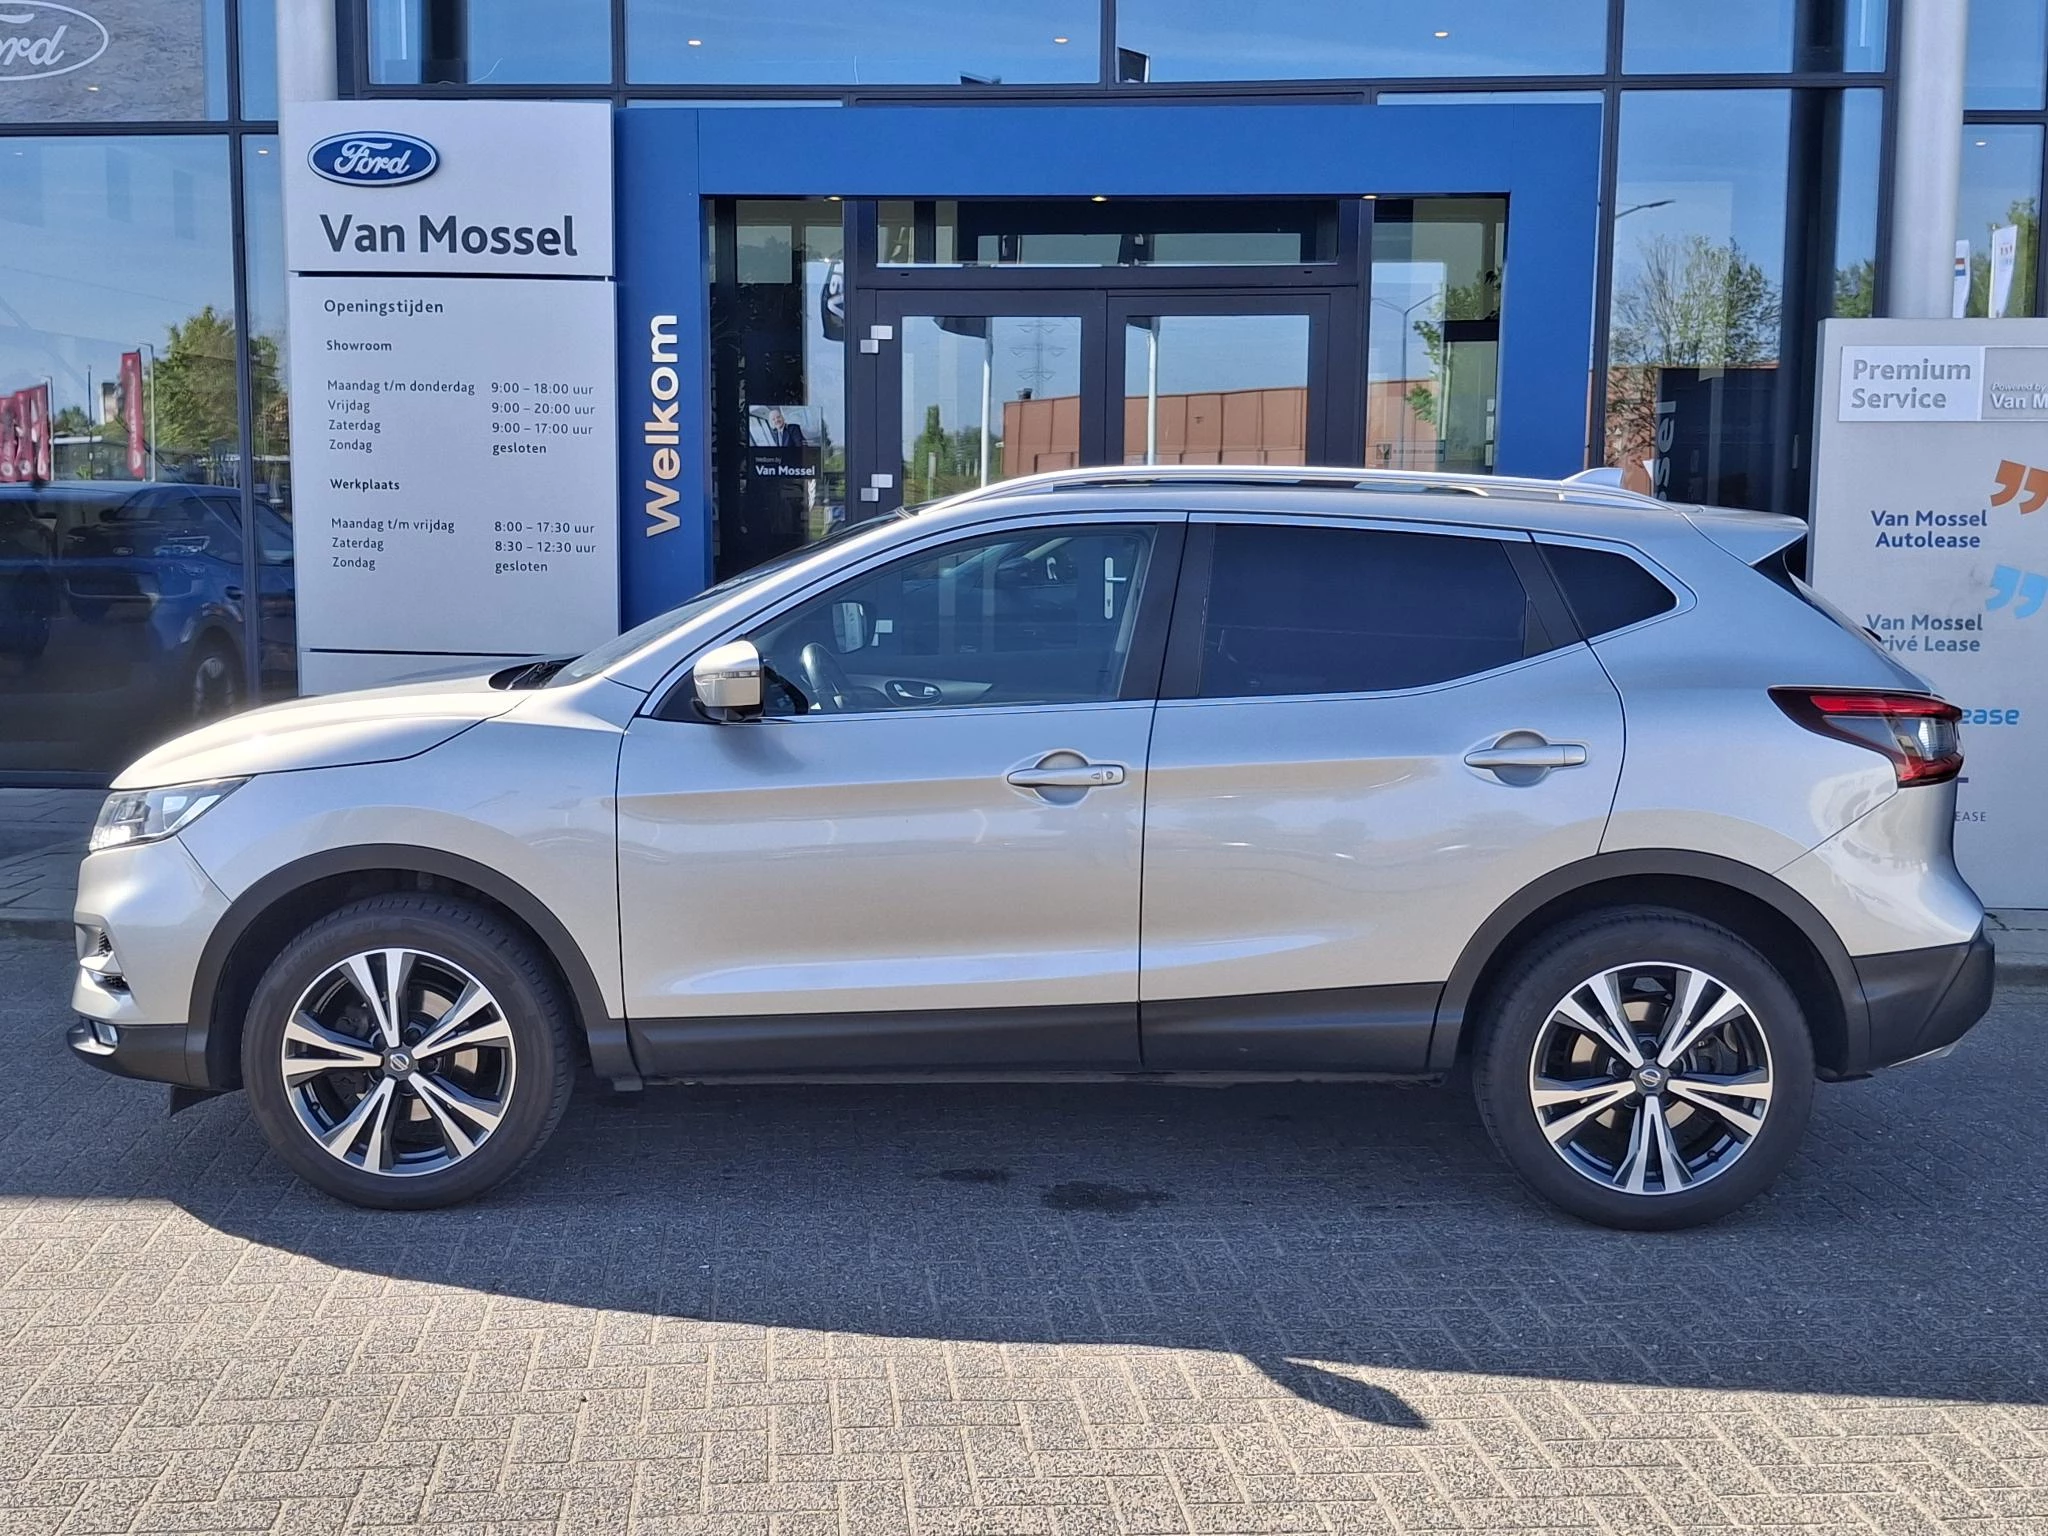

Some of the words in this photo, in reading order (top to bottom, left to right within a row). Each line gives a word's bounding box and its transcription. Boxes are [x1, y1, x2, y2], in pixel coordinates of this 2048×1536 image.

[333, 140, 412, 174] Ford
[320, 214, 406, 253] Van
[419, 215, 578, 257] Mossel
[324, 299, 444, 317] Openingstijden
[326, 339, 392, 351] Showroom
[1853, 358, 1971, 380] Premium
[327, 379, 381, 394] Maandag
[384, 380, 406, 392] t/m
[410, 380, 475, 396] donderdag
[491, 382, 520, 394] 9:00
[534, 382, 569, 395] 18:00
[573, 386, 594, 395] uur
[1851, 386, 1947, 409] Service
[1991, 393, 2026, 409] Van
[327, 399, 370, 414] Vrijdag
[491, 402, 520, 414] 9:00
[534, 403, 571, 415] 20:00
[574, 406, 596, 415] uur
[328, 419, 381, 434] Zaterdag
[492, 422, 521, 434] 9:00
[534, 423, 569, 435] 17:00
[572, 426, 594, 435] uur
[645, 314, 681, 537] Welkom
[329, 439, 372, 454] Zondag
[492, 442, 547, 456] gesloten
[755, 465, 776, 476] Van
[778, 465, 816, 476] Mossel
[330, 478, 400, 493] Werkplaats
[331, 518, 384, 532] Maandag
[387, 518, 410, 530] t/m
[413, 519, 455, 534] vrijdag
[494, 521, 523, 533] 8:00
[537, 522, 571, 534] 17:30
[574, 525, 595, 534] uur
[1871, 510, 1909, 526] Van
[1915, 509, 1988, 526] Mossel
[332, 537, 384, 552] Zaterdag
[495, 541, 523, 552] 8:30
[537, 541, 572, 553] 12:30
[575, 545, 597, 553] uur
[1875, 530, 1981, 548] Autolease
[332, 557, 375, 571] Zondag
[495, 560, 548, 575] gesloten
[1866, 614, 1905, 630] Van
[1911, 614, 1984, 631] Mossel
[1881, 635, 1919, 652] rivé
[1924, 636, 1981, 652] Lease
[1961, 709, 2020, 725] ease
[1955, 811, 1987, 822] EASE
